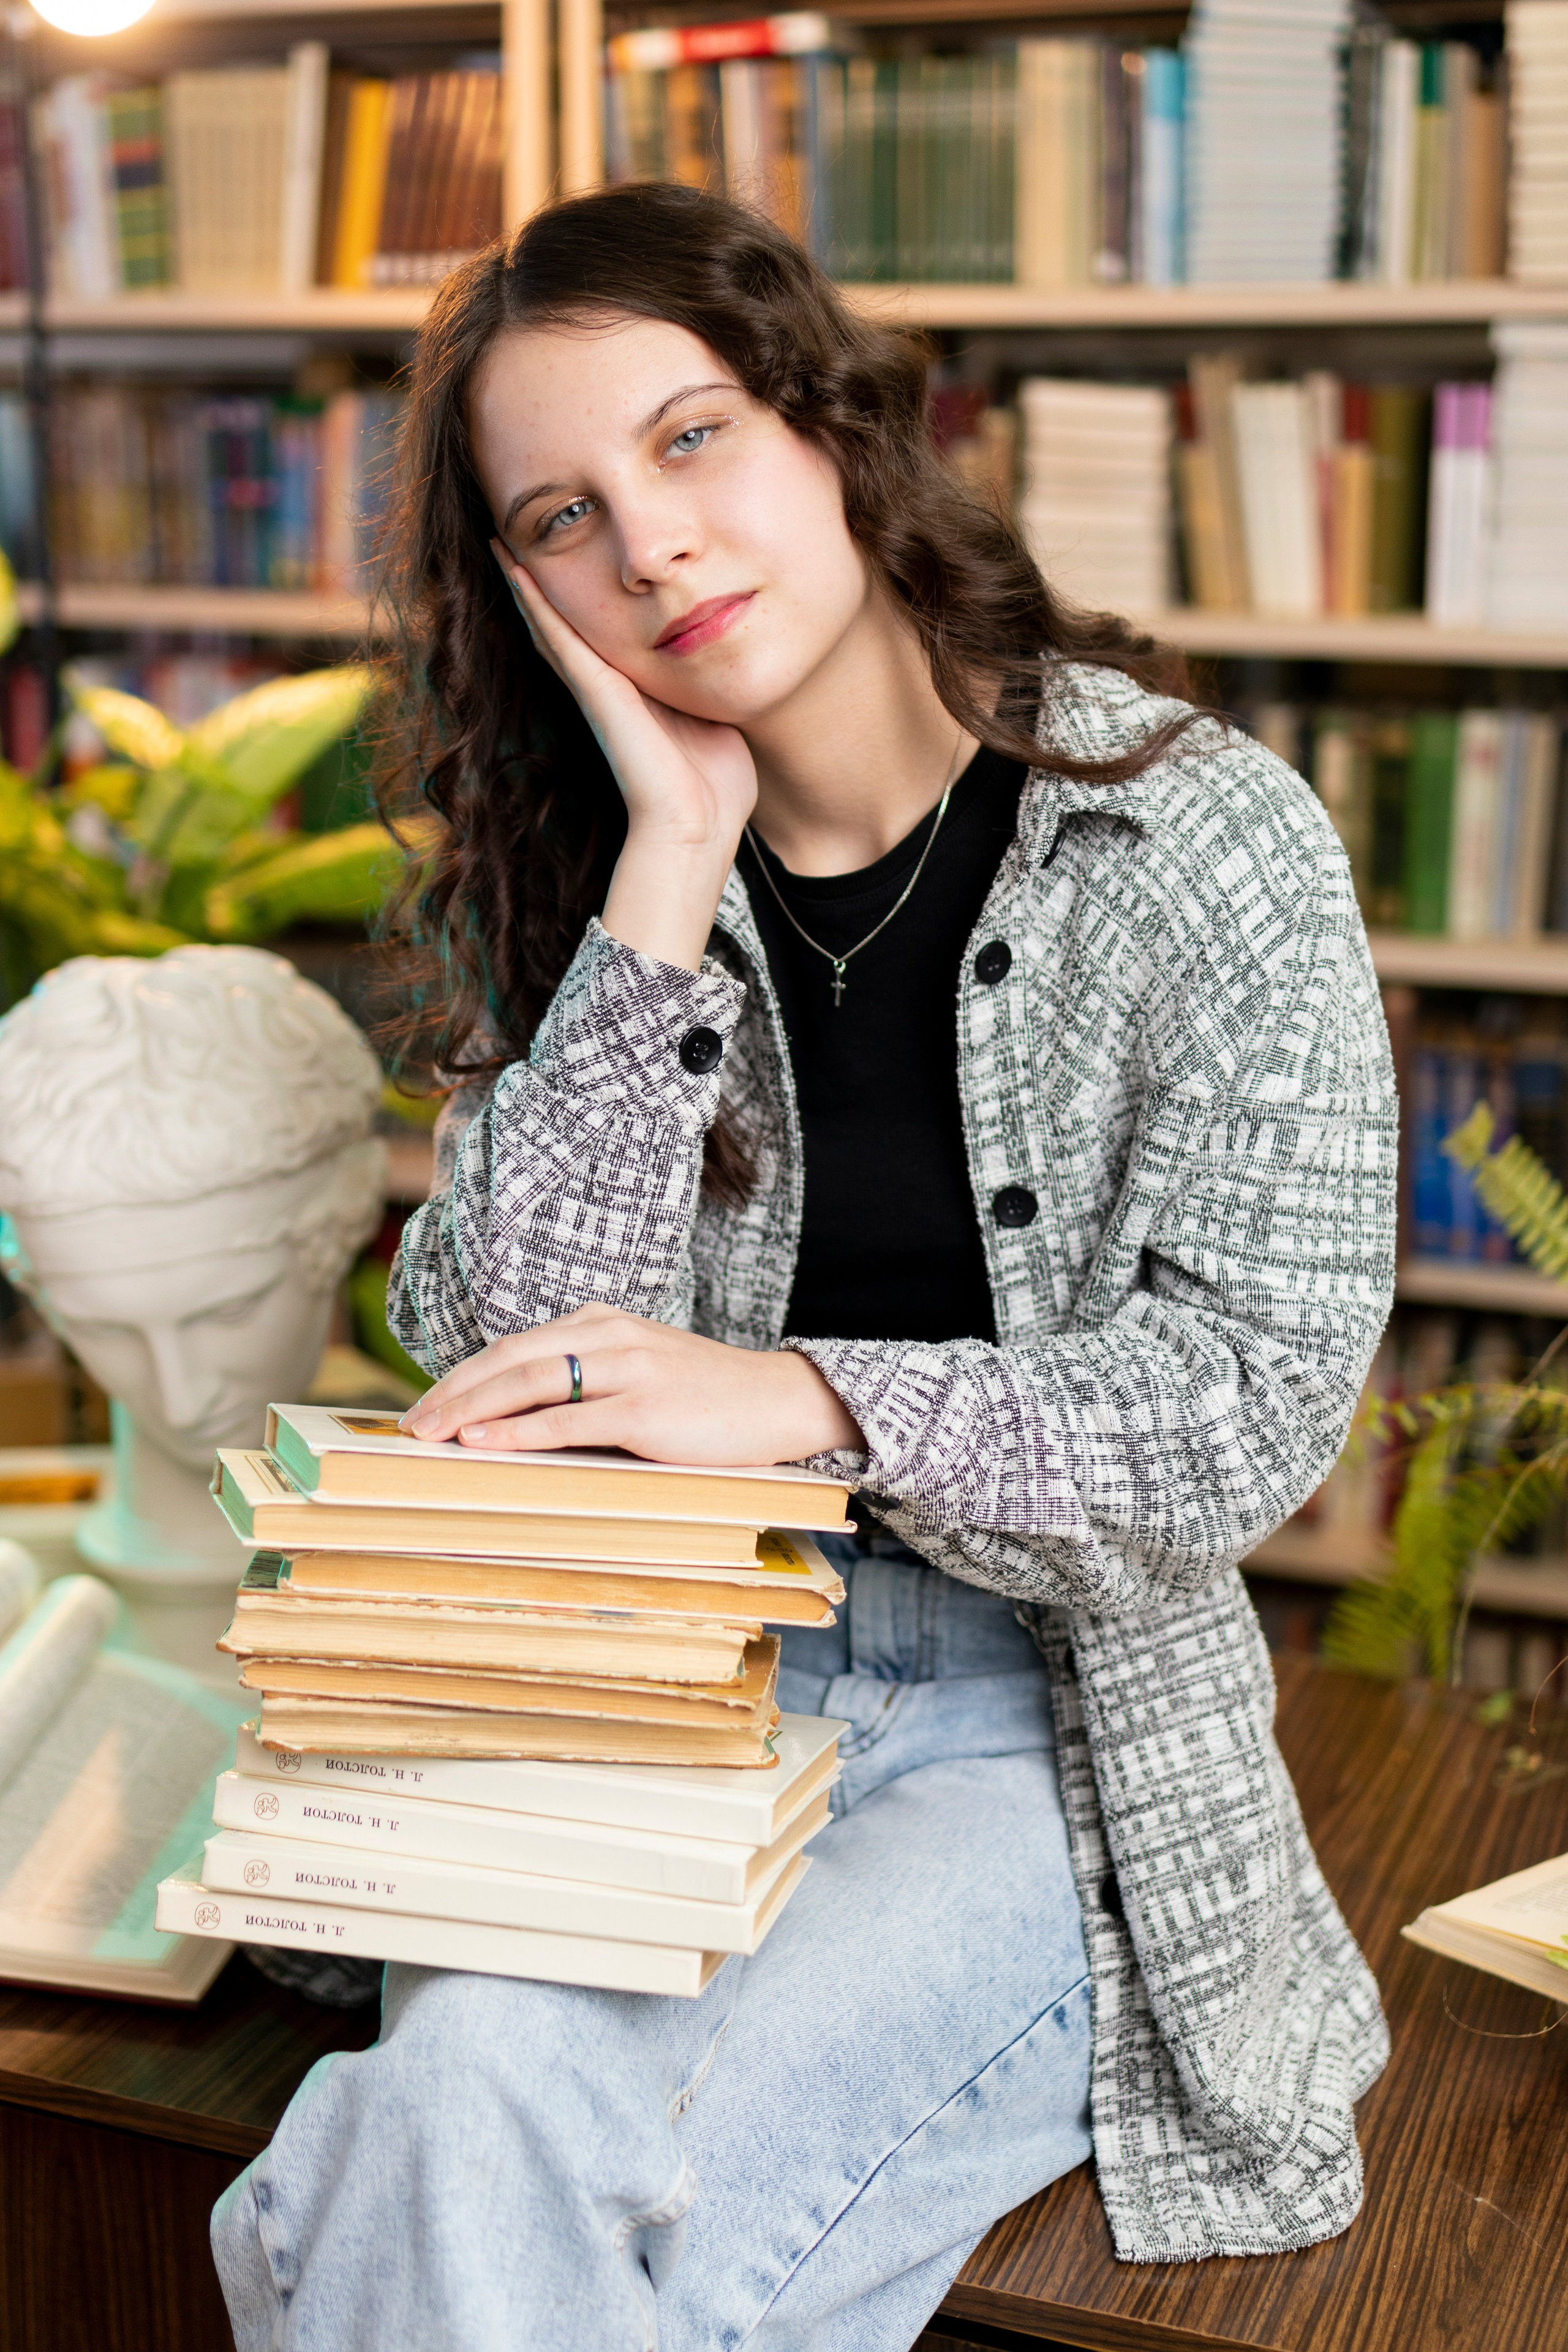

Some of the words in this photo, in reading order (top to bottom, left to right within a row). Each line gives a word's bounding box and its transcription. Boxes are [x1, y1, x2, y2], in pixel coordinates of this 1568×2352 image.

[325, 1758, 386, 1777] ТОЛСТОЙ
[392, 1768, 405, 1780] Н.
[411, 1771, 423, 1782] Л.
[303, 1806, 363, 1825] ТОЛСТОЙ
[369, 1817, 381, 1828] Н.
[387, 1820, 399, 1831] Л.
[295, 1872, 358, 1890] ТОЛСТОЙ
[364, 1880, 377, 1892] Н.
[383, 1883, 396, 1894] Л.
[245, 1915, 307, 1932] ТОЛСТОЙ
[313, 1922, 325, 1934] Н.
[332, 1924, 345, 1936] Л.
